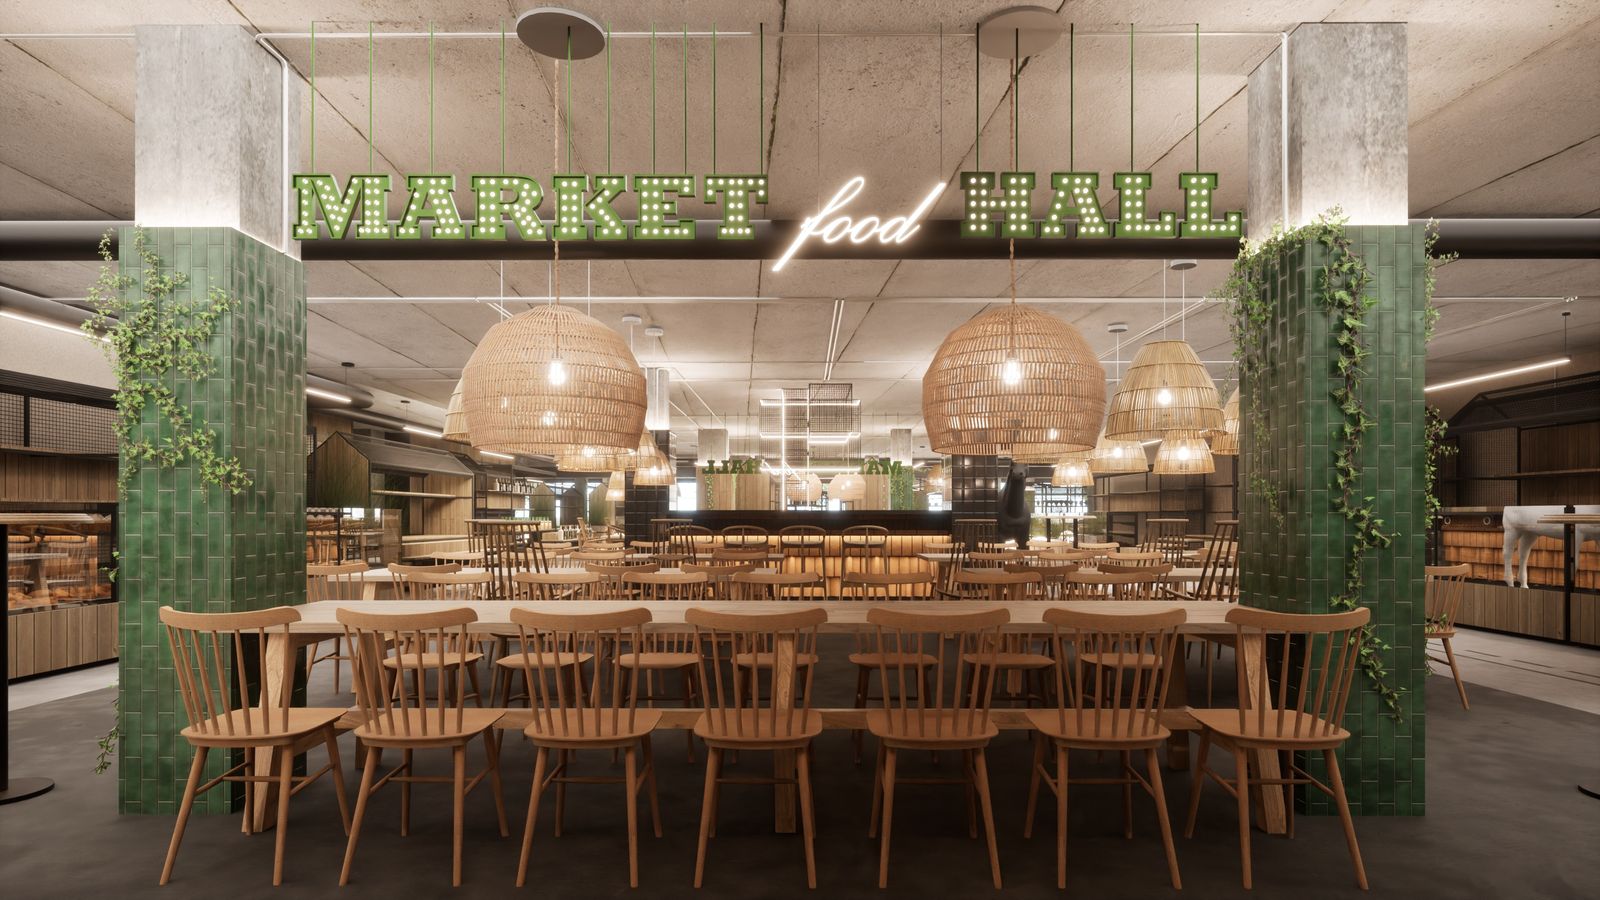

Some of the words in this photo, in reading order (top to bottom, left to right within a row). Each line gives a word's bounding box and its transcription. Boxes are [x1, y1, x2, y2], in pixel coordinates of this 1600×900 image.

[292, 174, 768, 240] MARKET
[772, 176, 946, 271] food
[960, 172, 1243, 238] HALL
